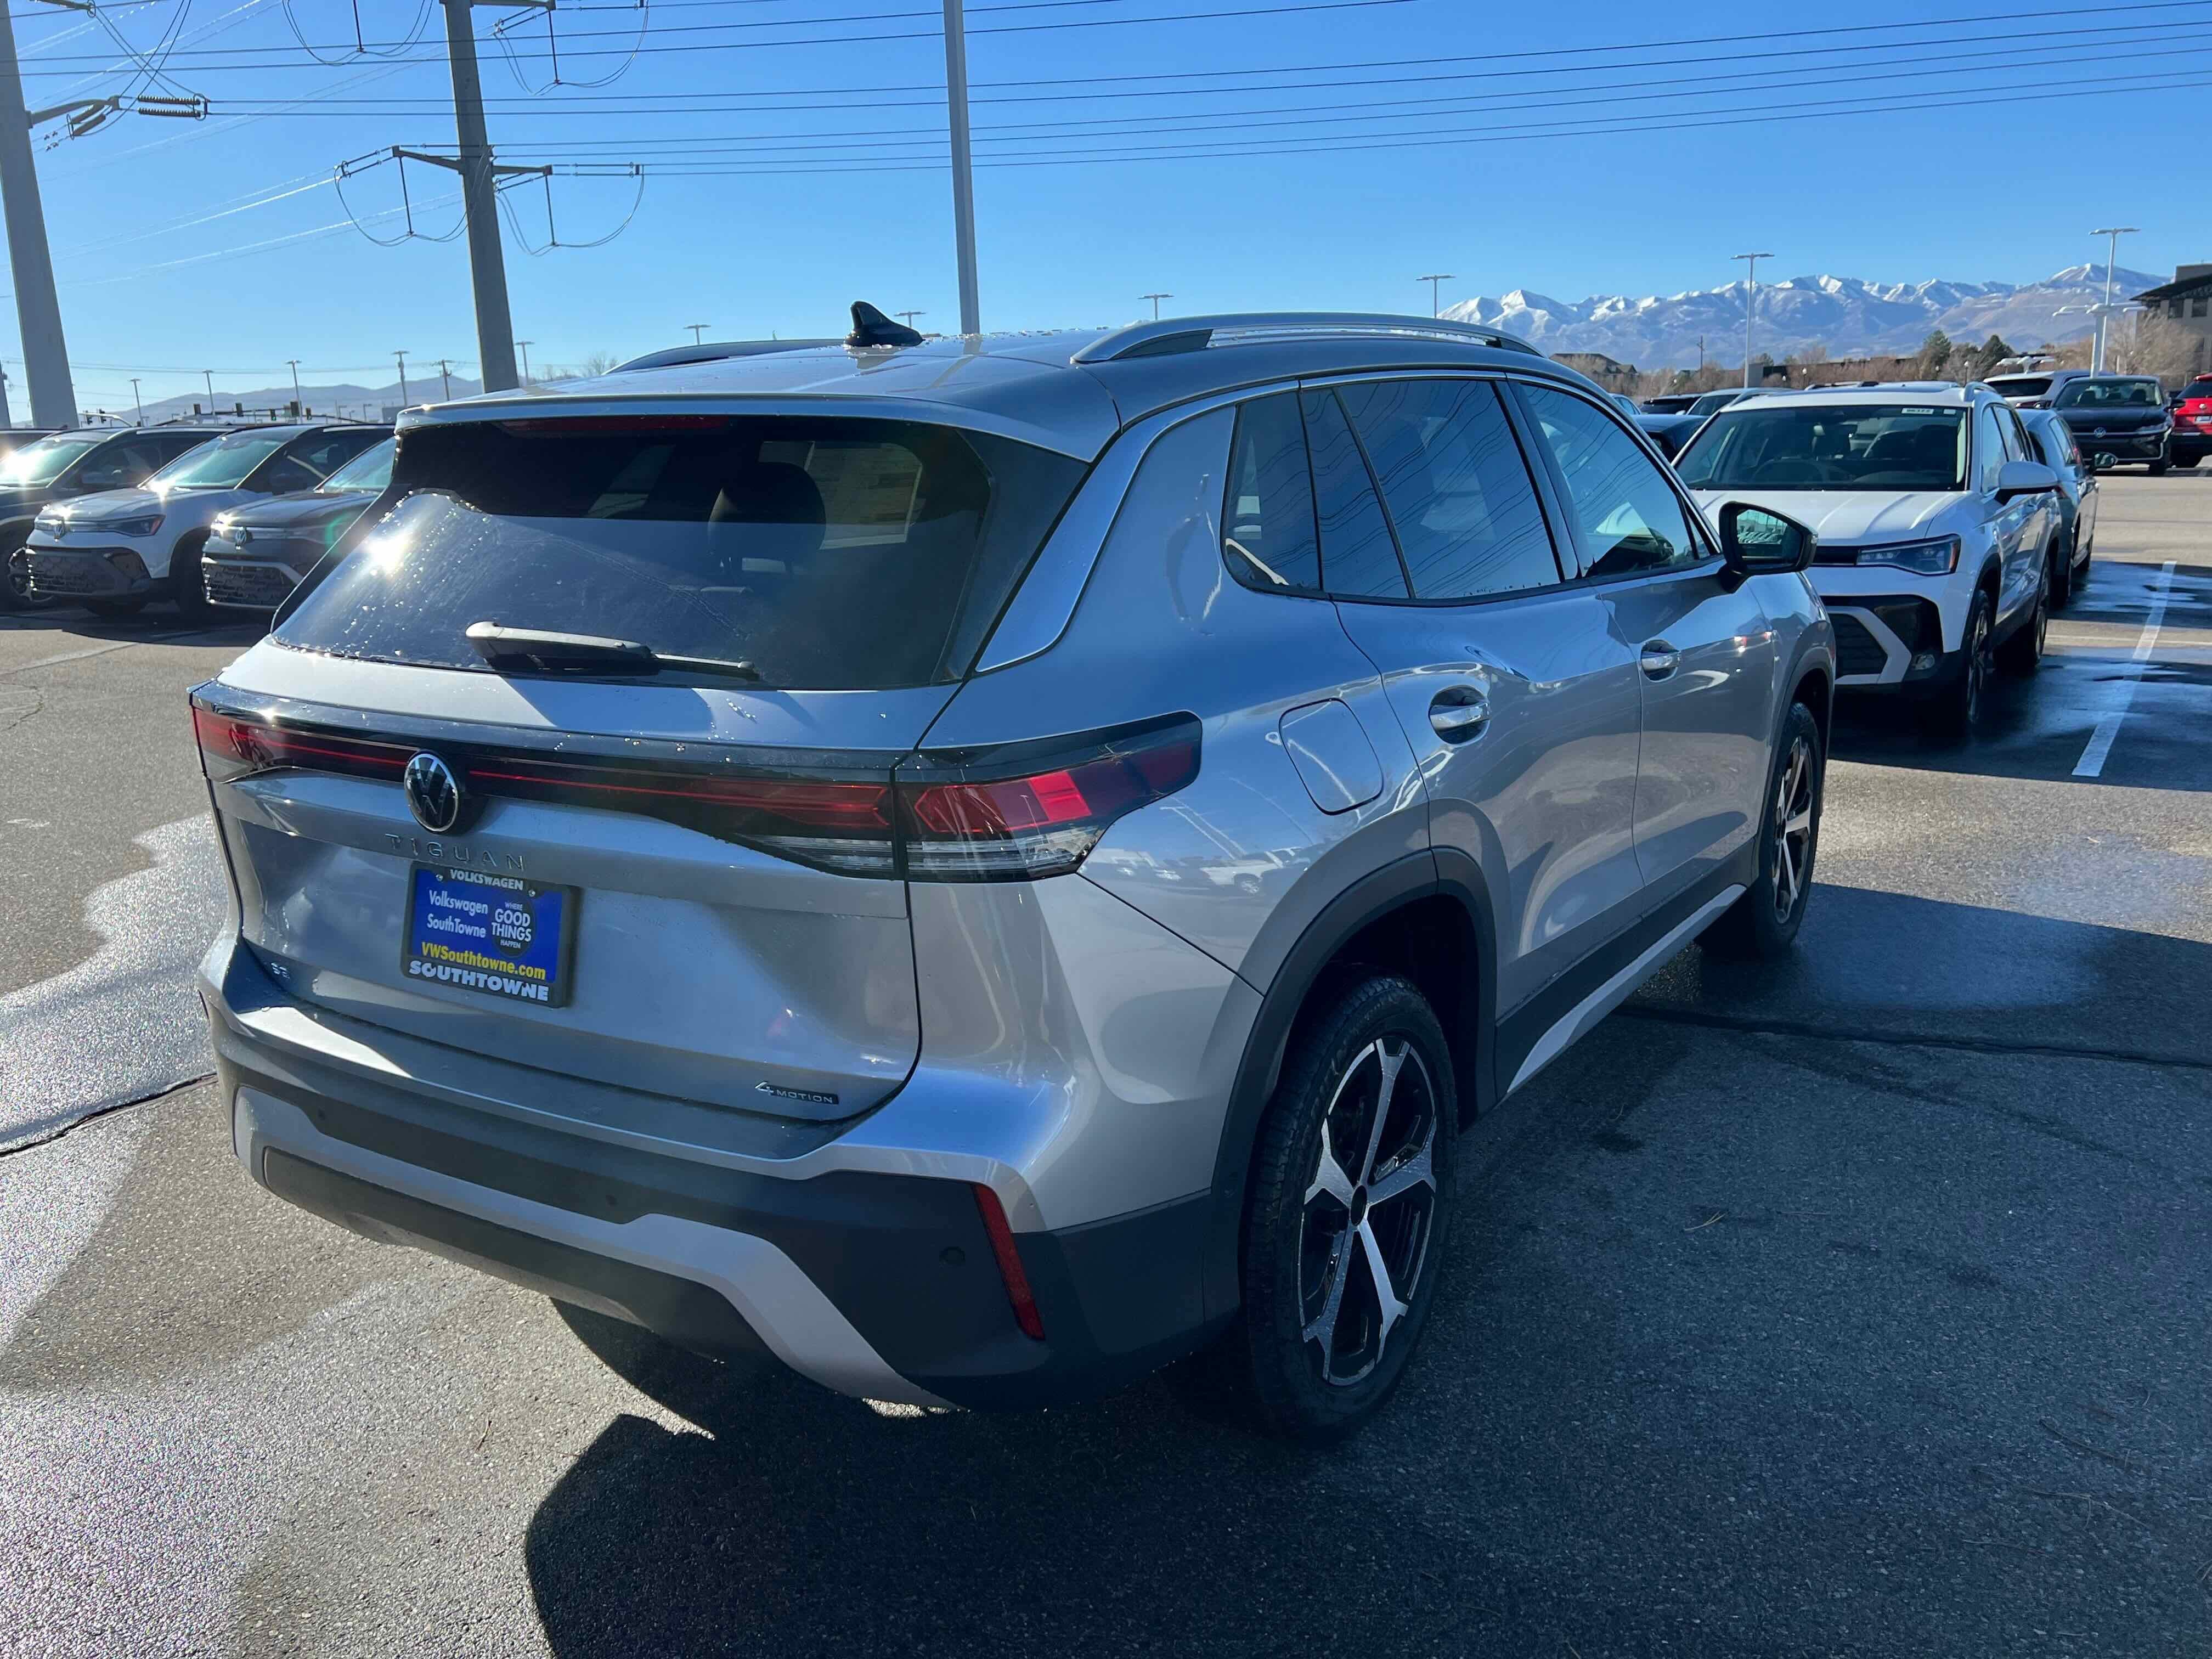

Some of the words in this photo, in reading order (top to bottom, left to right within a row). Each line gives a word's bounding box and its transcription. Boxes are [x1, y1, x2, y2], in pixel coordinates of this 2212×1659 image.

[385, 833, 525, 871] TIGUAN
[450, 869, 523, 890] VOLKSWAGEN
[429, 890, 488, 917] Volkswagen
[504, 901, 523, 911] WHERE
[427, 913, 486, 938] SouthTowne
[495, 909, 531, 927] GOOD
[492, 922, 532, 942] THINGS
[500, 939, 521, 949] HAPPEN
[421, 941, 545, 979] VWSouthtowne.com
[409, 960, 549, 1001] SOUTHTOWNE
